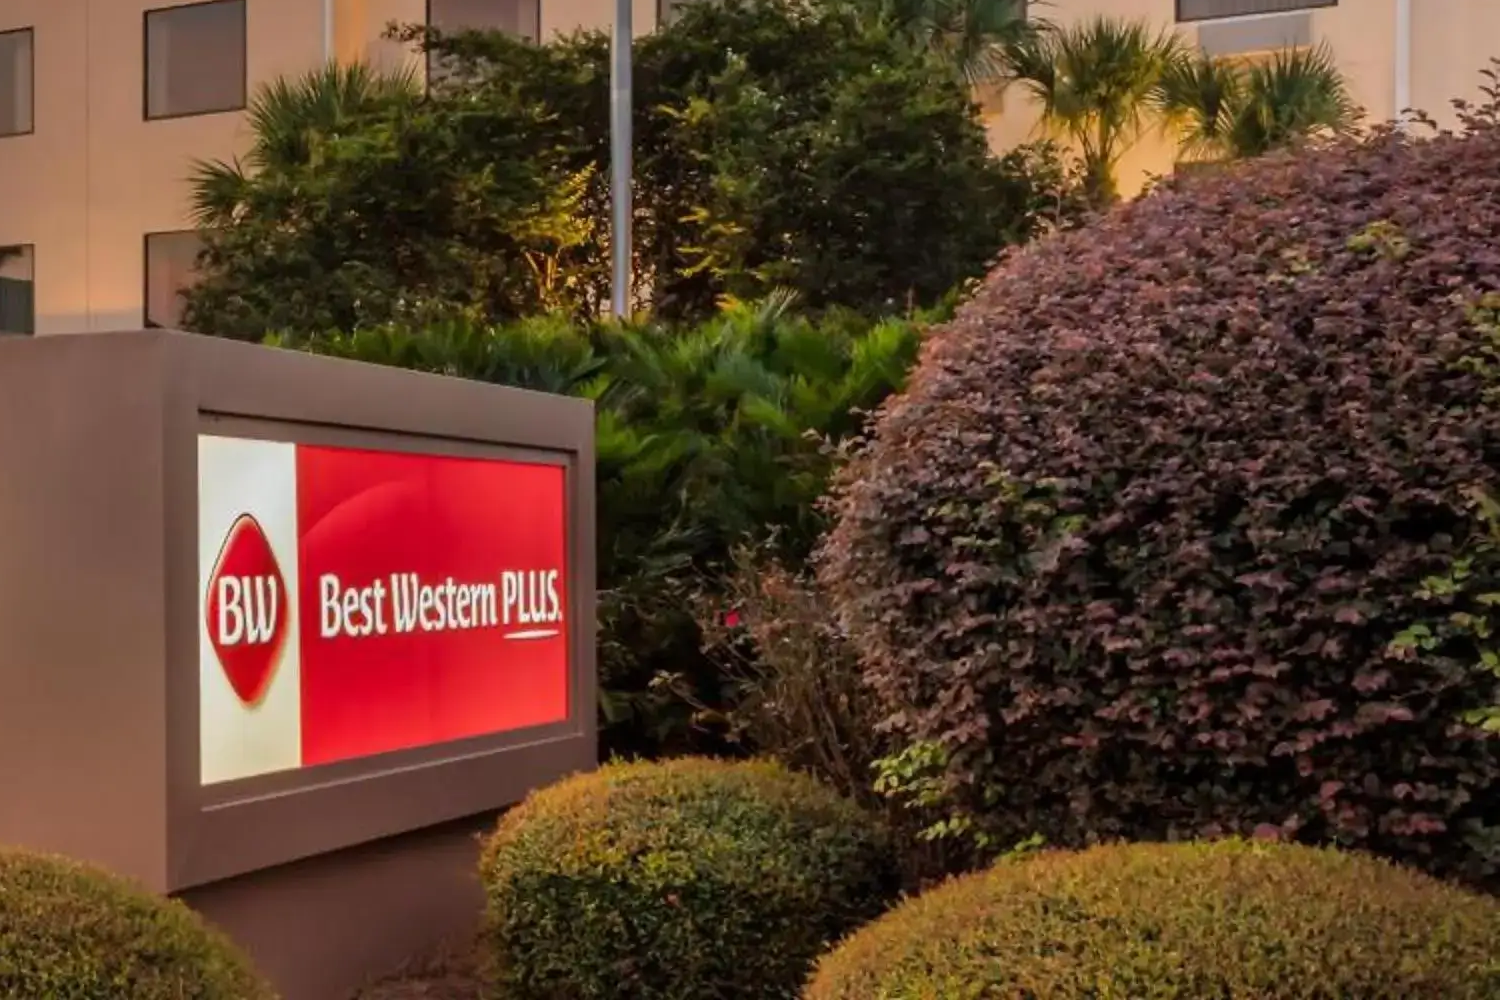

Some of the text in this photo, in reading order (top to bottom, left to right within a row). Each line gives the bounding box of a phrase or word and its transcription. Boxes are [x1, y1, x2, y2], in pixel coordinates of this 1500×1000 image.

[218, 575, 278, 645] BW
[319, 573, 387, 638] Best
[390, 572, 498, 633] Western
